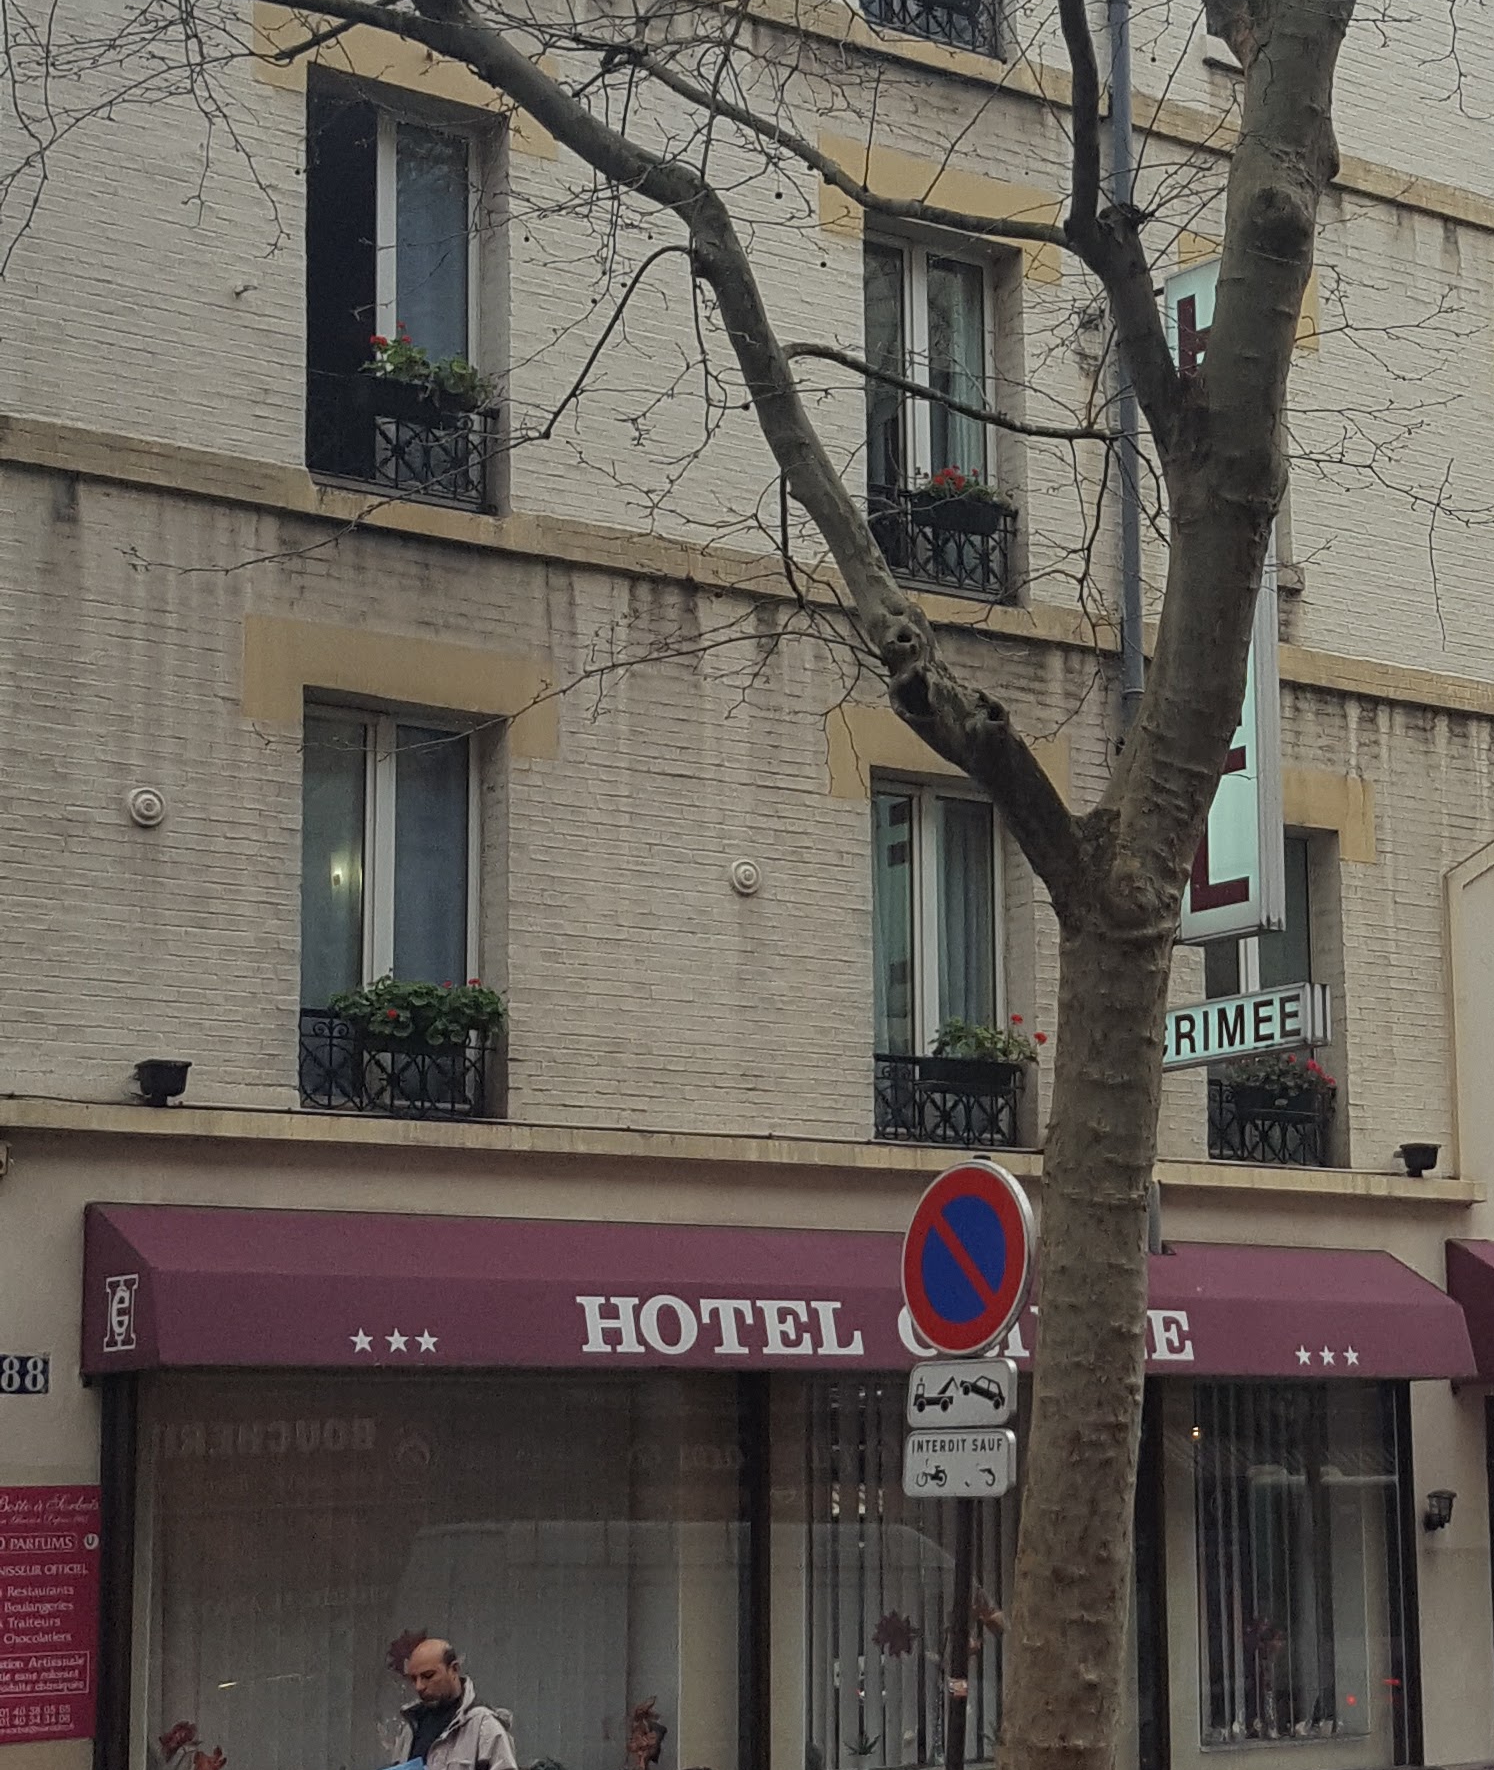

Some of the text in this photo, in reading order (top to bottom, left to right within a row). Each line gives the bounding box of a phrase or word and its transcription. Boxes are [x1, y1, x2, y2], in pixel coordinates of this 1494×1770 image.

[1163, 993, 1302, 1057] RIMEE
[576, 1295, 864, 1355] HOTEL
[912, 1437, 1003, 1454] INTERDIT SAUF
[10, 1536, 73, 1550] PARFUMS
[8, 1586, 74, 1597] Restaurants
[5, 1601, 74, 1615] Boulangeries
[7, 1617, 61, 1629] Traiteurs
[4, 1631, 72, 1644] Chocolatiers
